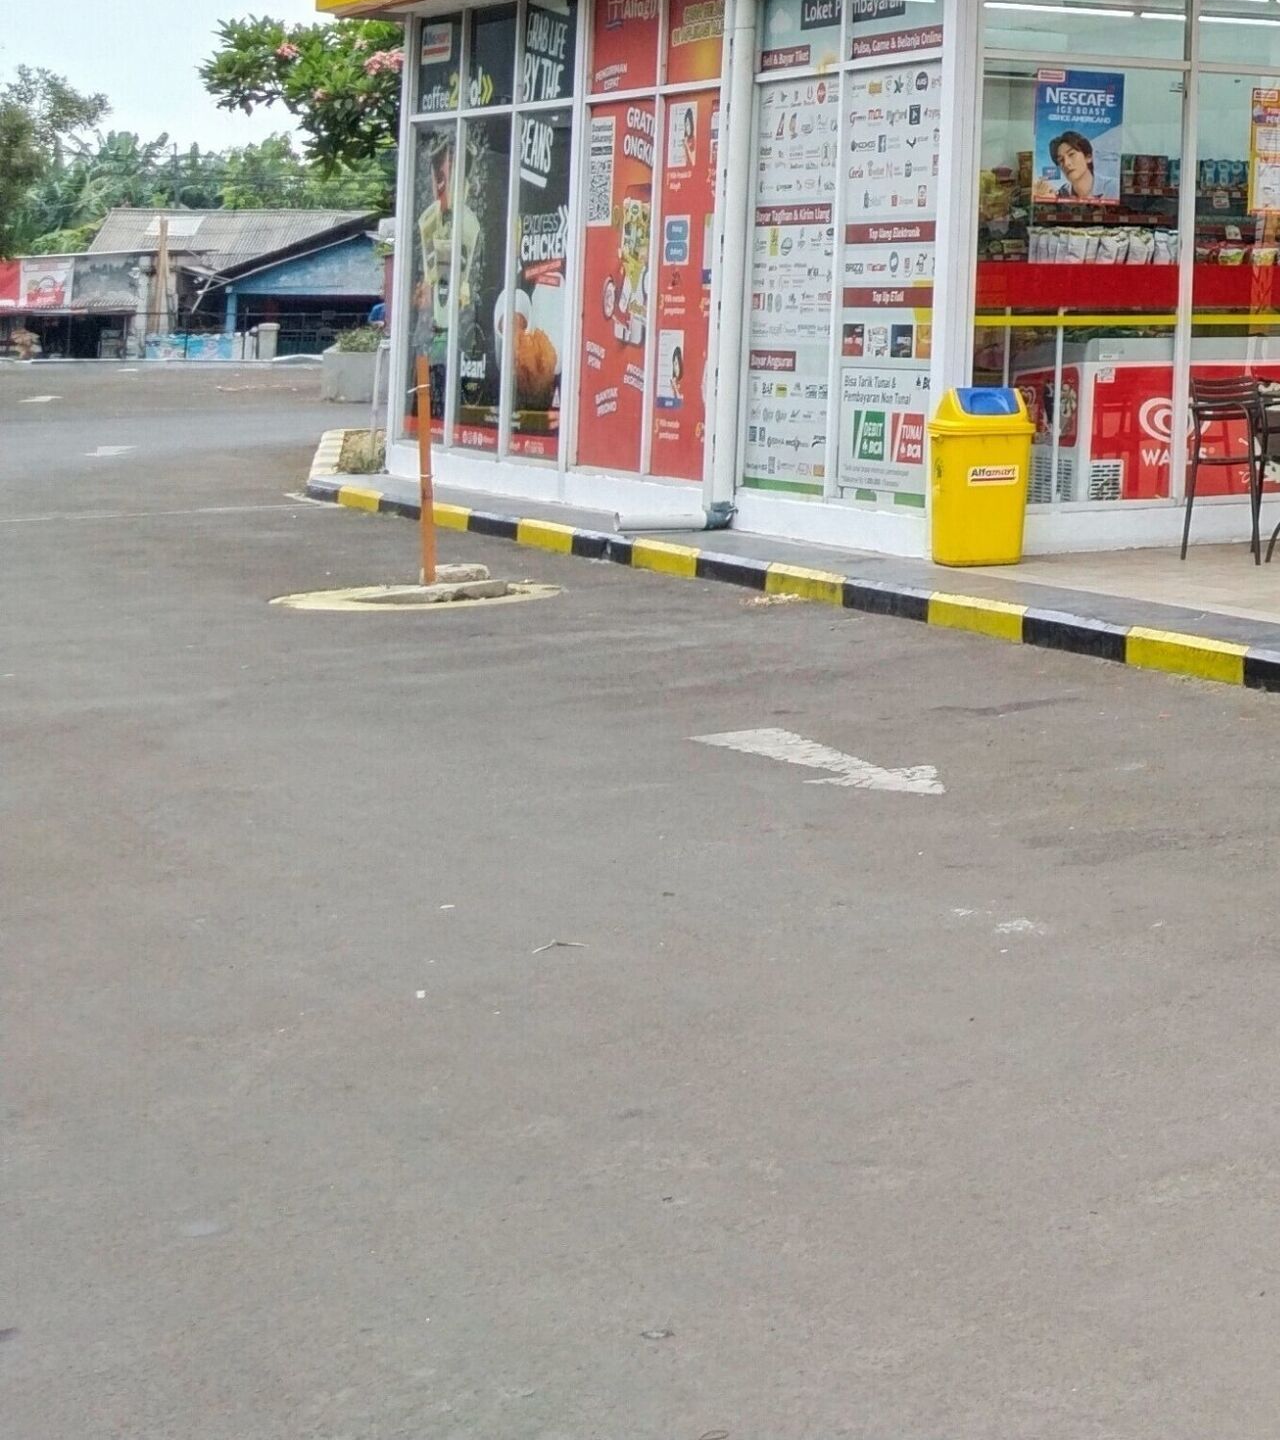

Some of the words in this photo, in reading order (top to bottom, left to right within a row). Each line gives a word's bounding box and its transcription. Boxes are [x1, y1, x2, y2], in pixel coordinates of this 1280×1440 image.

[804, 0, 833, 22] Loket
[527, 12, 549, 54] GRAB
[549, 22, 568, 60] LIFE
[854, 41, 872, 56] Pulsa,
[872, 39, 890, 51] Game
[897, 34, 920, 49] Belanja
[921, 31, 942, 44] Online
[523, 53, 540, 102] BY
[1075, 106, 1106, 116] ROAST
[627, 107, 656, 138] GRATI
[520, 119, 554, 174] BEANS
[623, 134, 653, 167] ONGKI
[522, 212, 558, 236] express
[771, 209, 793, 225] Tagihan
[815, 208, 830, 223] Uang
[892, 226, 920, 239] Elektronik
[521, 228, 568, 261] CHICKEN
[461, 352, 486, 379] bean!
[844, 375, 857, 387] Bisa
[858, 375, 873, 388] Tarik
[874, 376, 890, 389] Tunai
[844, 390, 880, 404] Pembayaran
[881, 392, 893, 404] Non
[894, 392, 912, 405] Tunai
[863, 422, 883, 438] DEBIT
[901, 424, 923, 440] TUNAI
[868, 441, 883, 455] BCA
[906, 444, 921, 458] BCA
[1142, 447, 1208, 466] WAS
[971, 466, 1016, 477] Alfamart
